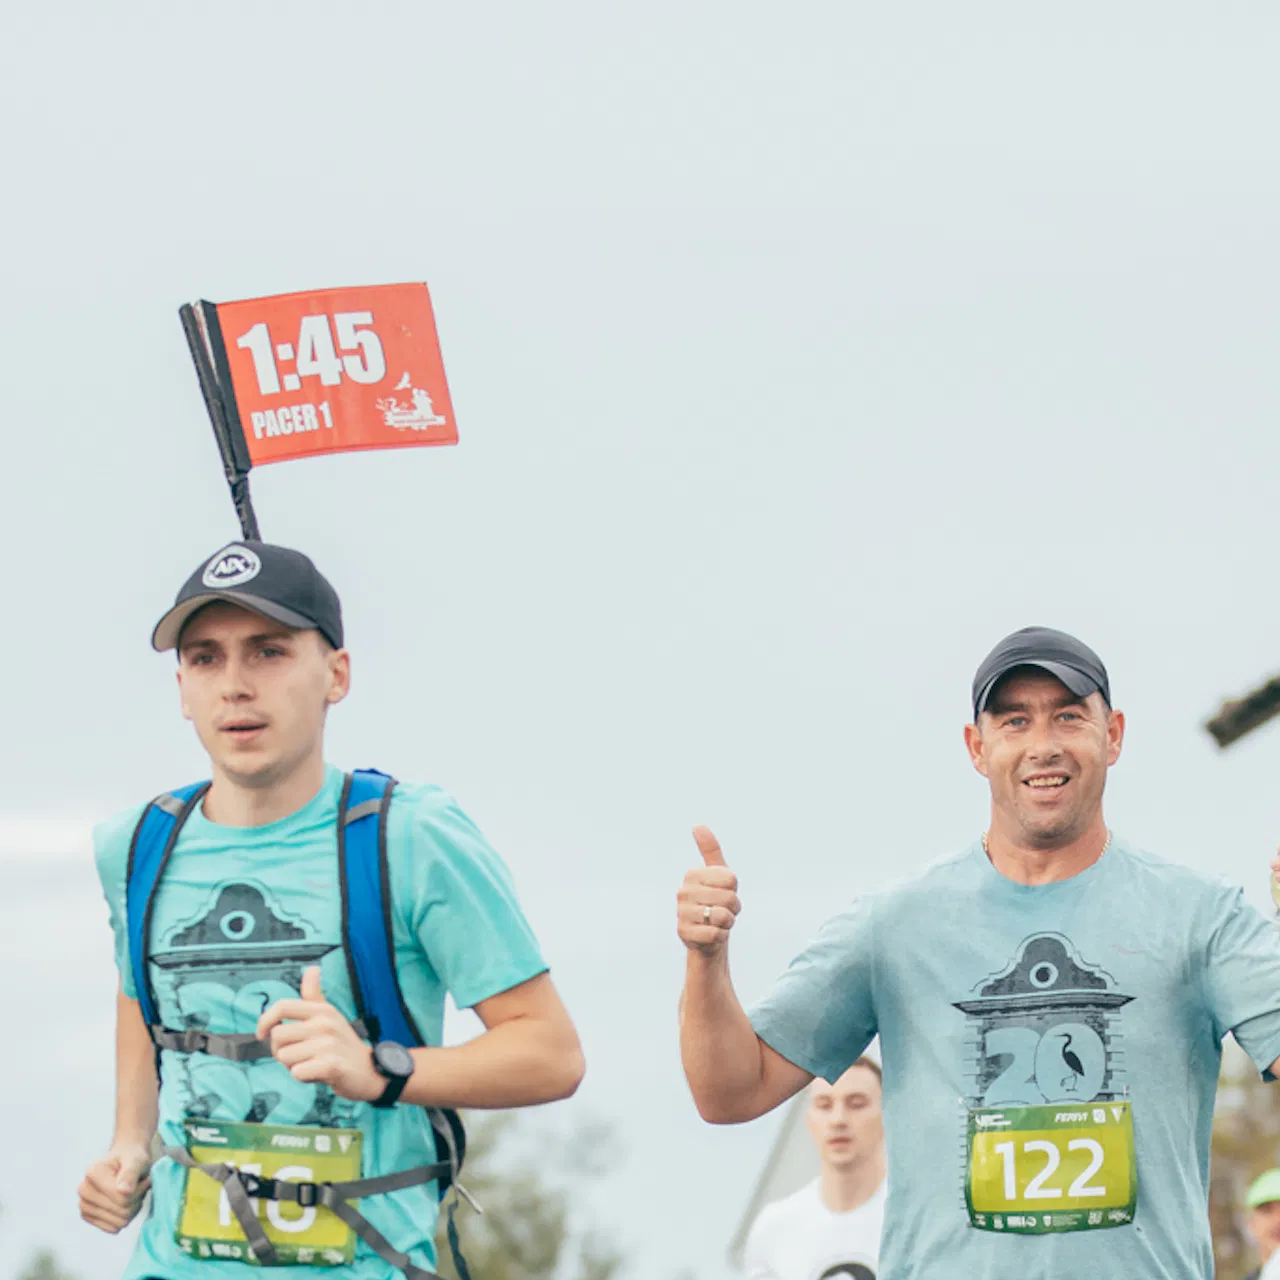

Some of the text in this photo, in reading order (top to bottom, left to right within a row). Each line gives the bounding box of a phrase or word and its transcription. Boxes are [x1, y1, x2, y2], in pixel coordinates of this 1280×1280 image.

[236, 311, 387, 396] 1:45
[250, 401, 333, 440] PACER 1
[994, 1137, 1107, 1200] 122
